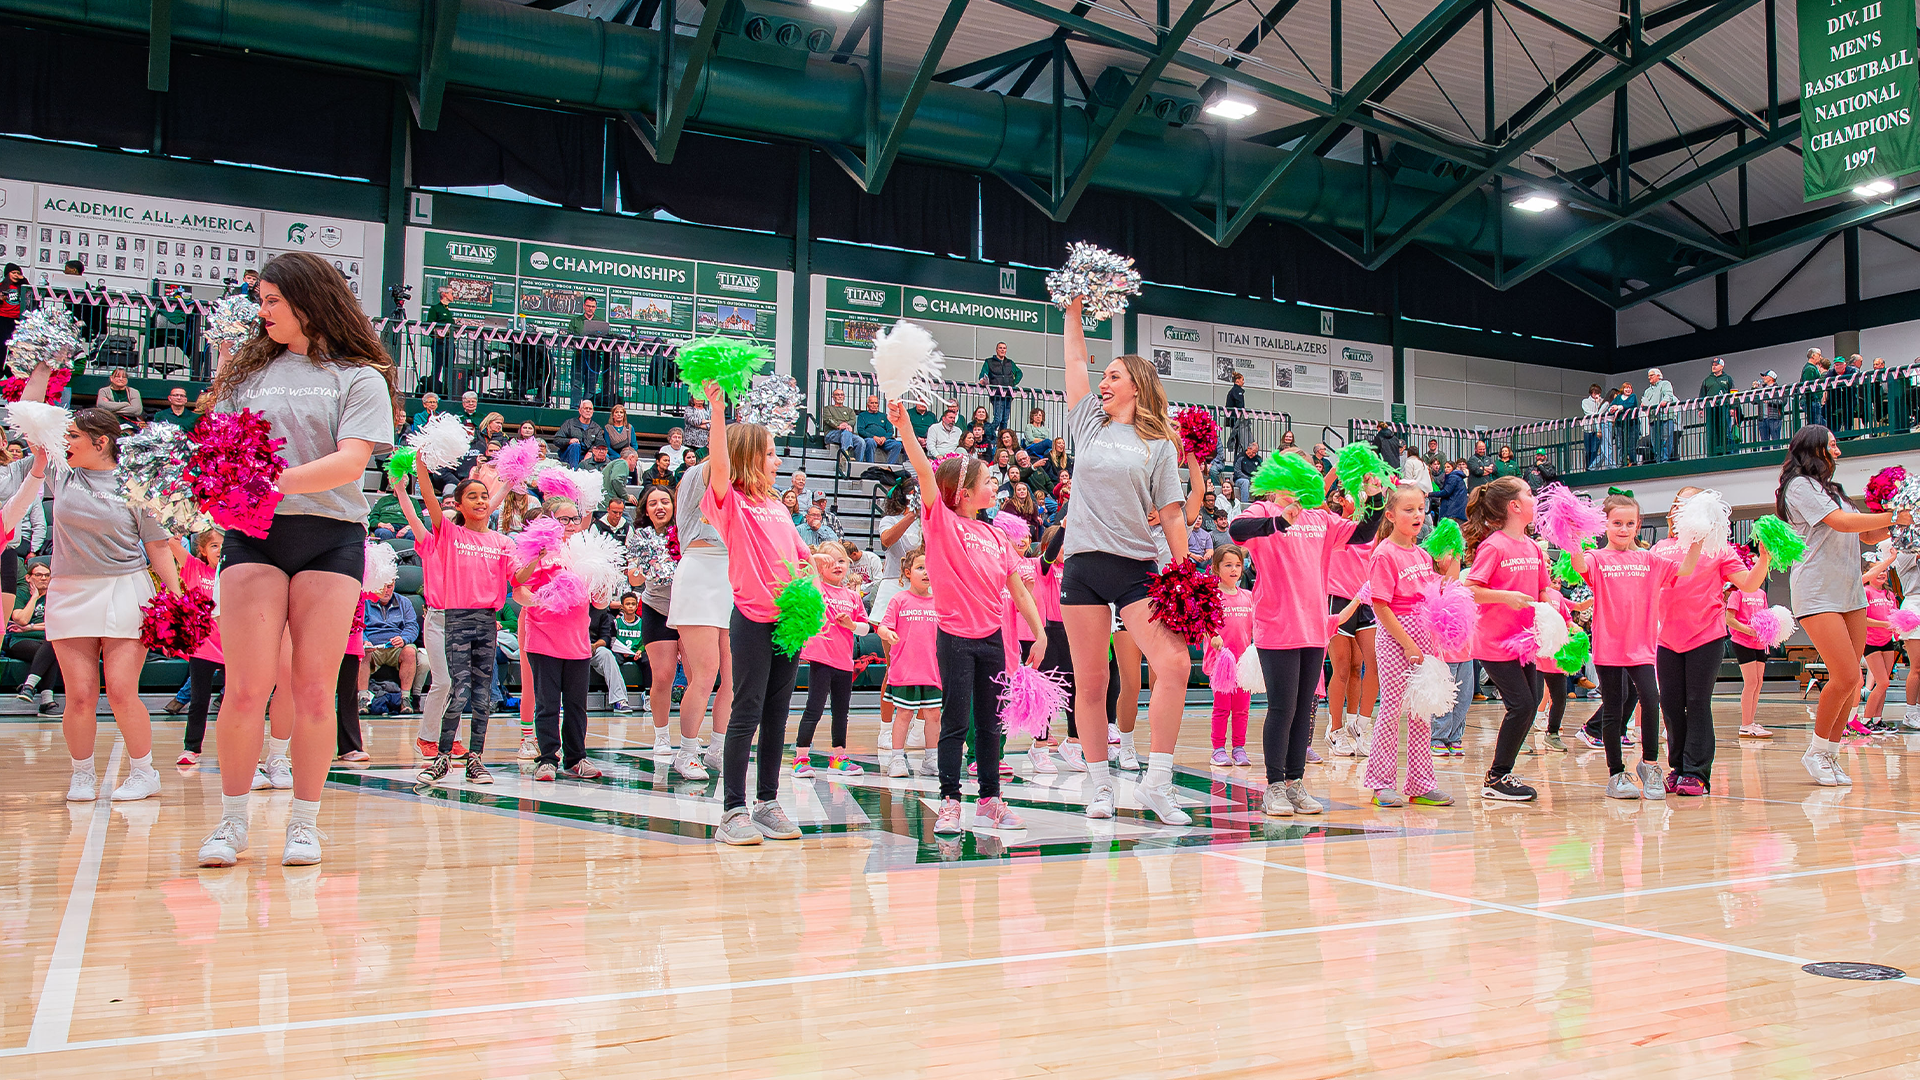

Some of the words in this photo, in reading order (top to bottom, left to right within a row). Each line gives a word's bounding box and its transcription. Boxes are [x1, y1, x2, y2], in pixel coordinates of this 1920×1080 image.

[1827, 10, 1859, 35] DIV.
[1862, 2, 1882, 23] III
[1830, 30, 1882, 62] MEN'S
[1804, 49, 1914, 98] BASKETBALL
[1815, 82, 1900, 123] NATIONAL
[1810, 108, 1910, 152] CHAMPIONS
[1844, 146, 1876, 171] 1997
[44, 198, 134, 220] ACADEMIC
[141, 210, 255, 234] ALL-AMERICA
[416, 198, 428, 218] L
[450, 244, 496, 258] TITANS
[552, 256, 686, 283] CHAMPIONSHIPS
[720, 274, 758, 288] TITANS
[1001, 272, 1014, 290] M
[847, 288, 884, 302] TITANS
[930, 299, 1038, 324] CHAMPIONSHIPS
[1323, 316, 1332, 332] N
[1173, 332, 1200, 342] TITANS
[1218, 331, 1250, 345] TITAN
[1253, 336, 1327, 354] TRAILBLAZERS
[1351, 352, 1373, 362] TITANS
[289, 387, 341, 399] WESLEYAN
[1090, 438, 1113, 449] LINOIS
[626, 640, 632, 650] 2
